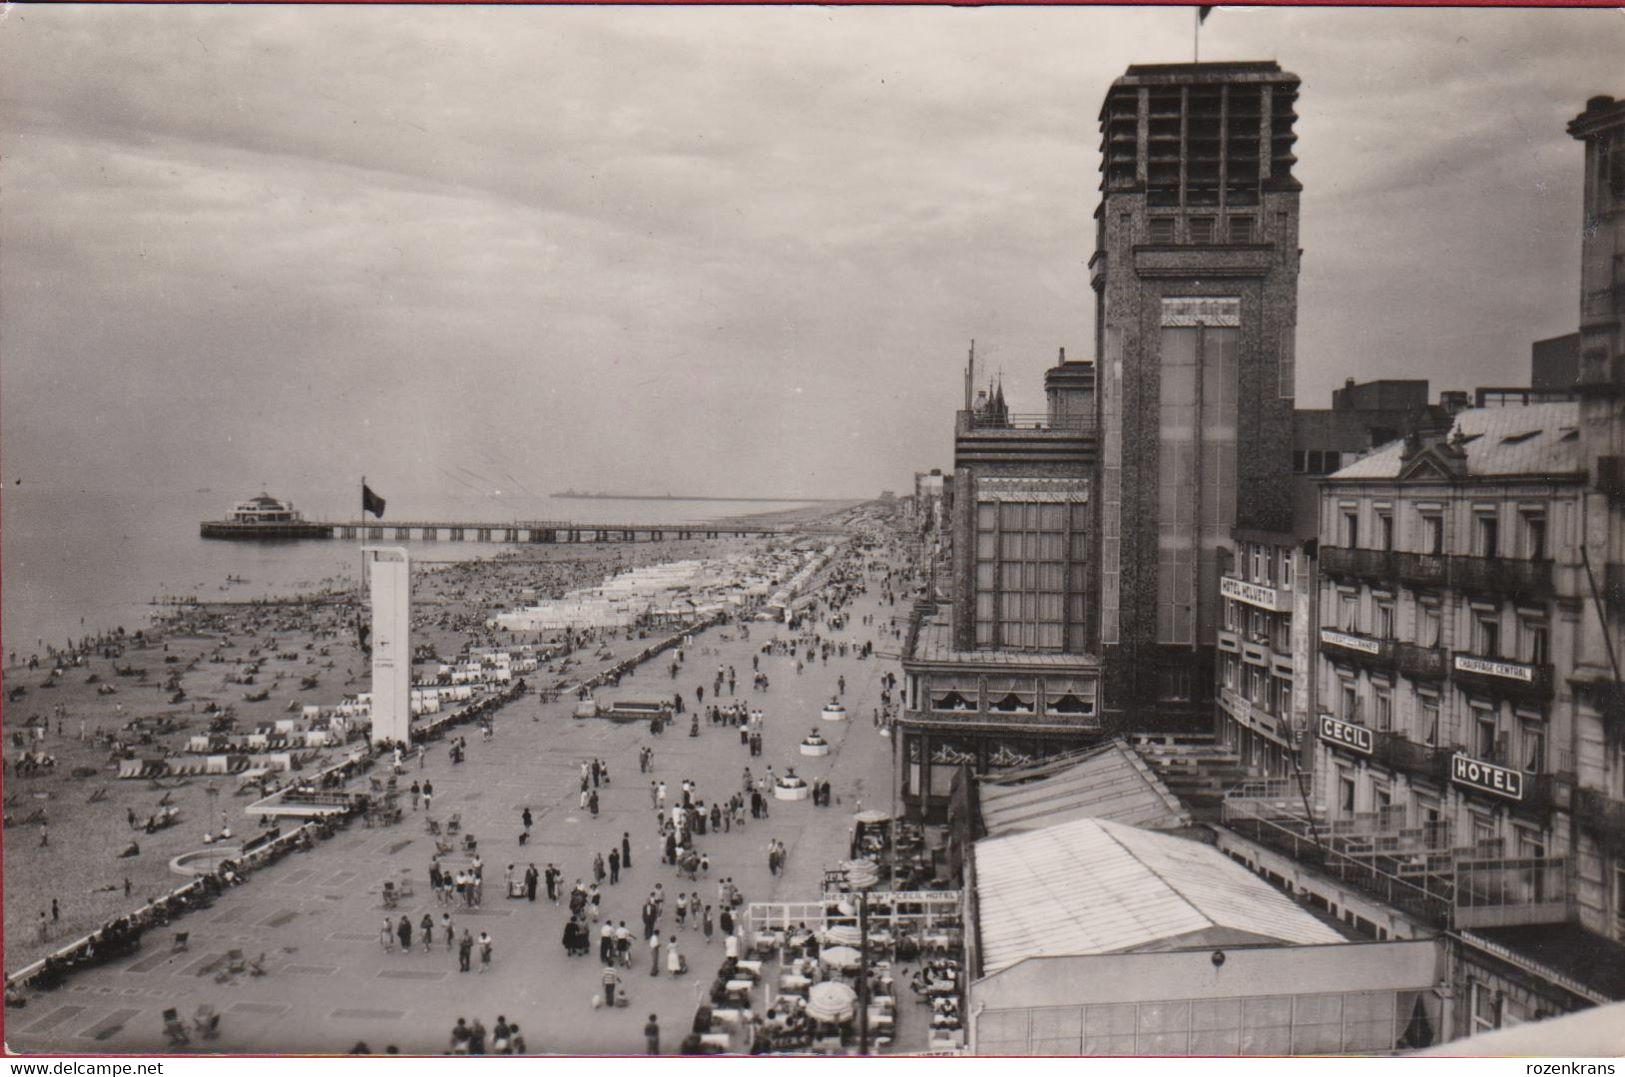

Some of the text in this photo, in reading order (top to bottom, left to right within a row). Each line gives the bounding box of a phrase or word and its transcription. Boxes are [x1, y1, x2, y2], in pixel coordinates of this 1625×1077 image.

[1223, 579, 1240, 596] HOTEL
[1460, 658, 1526, 679] CHAUFFAGE CENTRAL
[1324, 720, 1367, 747] CECIL
[1457, 759, 1516, 793] HOTEL
